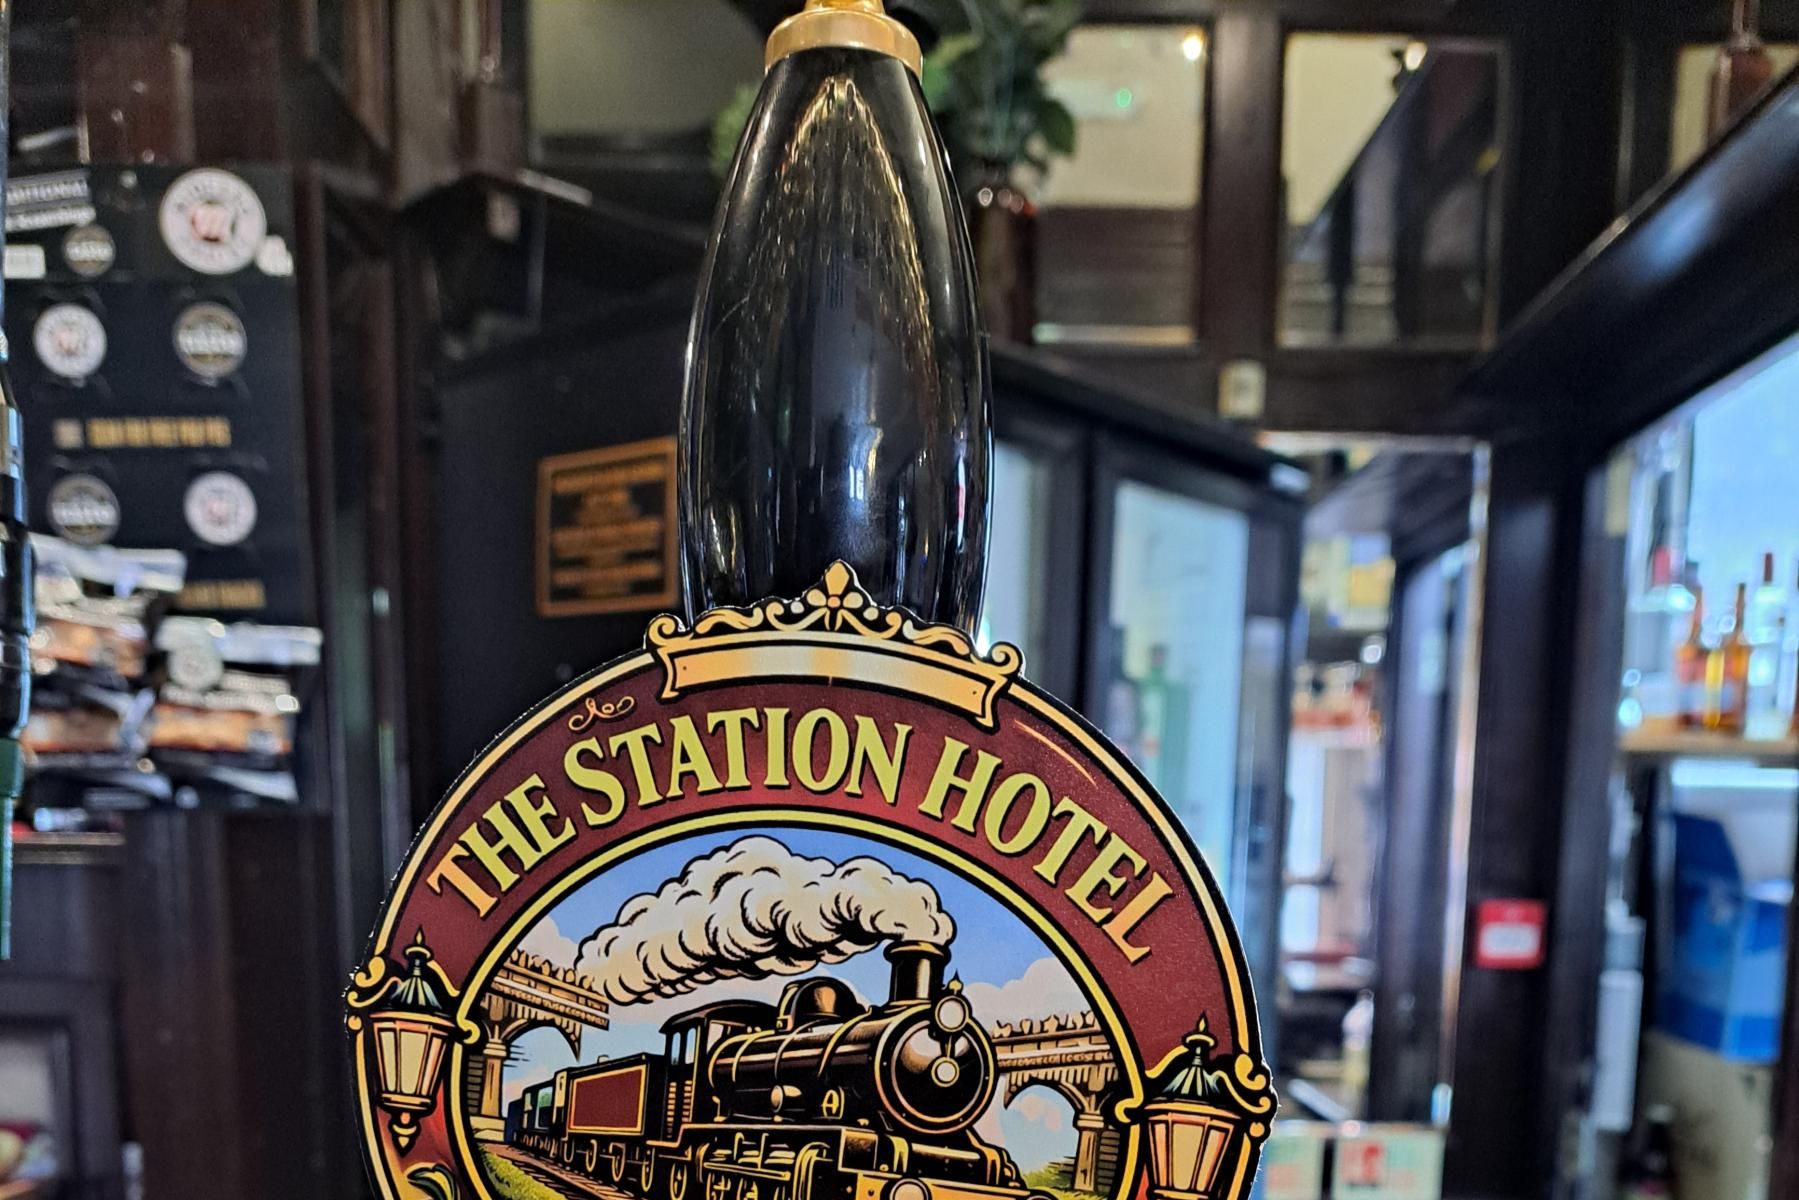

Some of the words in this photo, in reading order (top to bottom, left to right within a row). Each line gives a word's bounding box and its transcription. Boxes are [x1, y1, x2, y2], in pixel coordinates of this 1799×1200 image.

[426, 774, 577, 918] THE
[564, 707, 913, 827] STATION
[918, 736, 1174, 965] HOTEL
